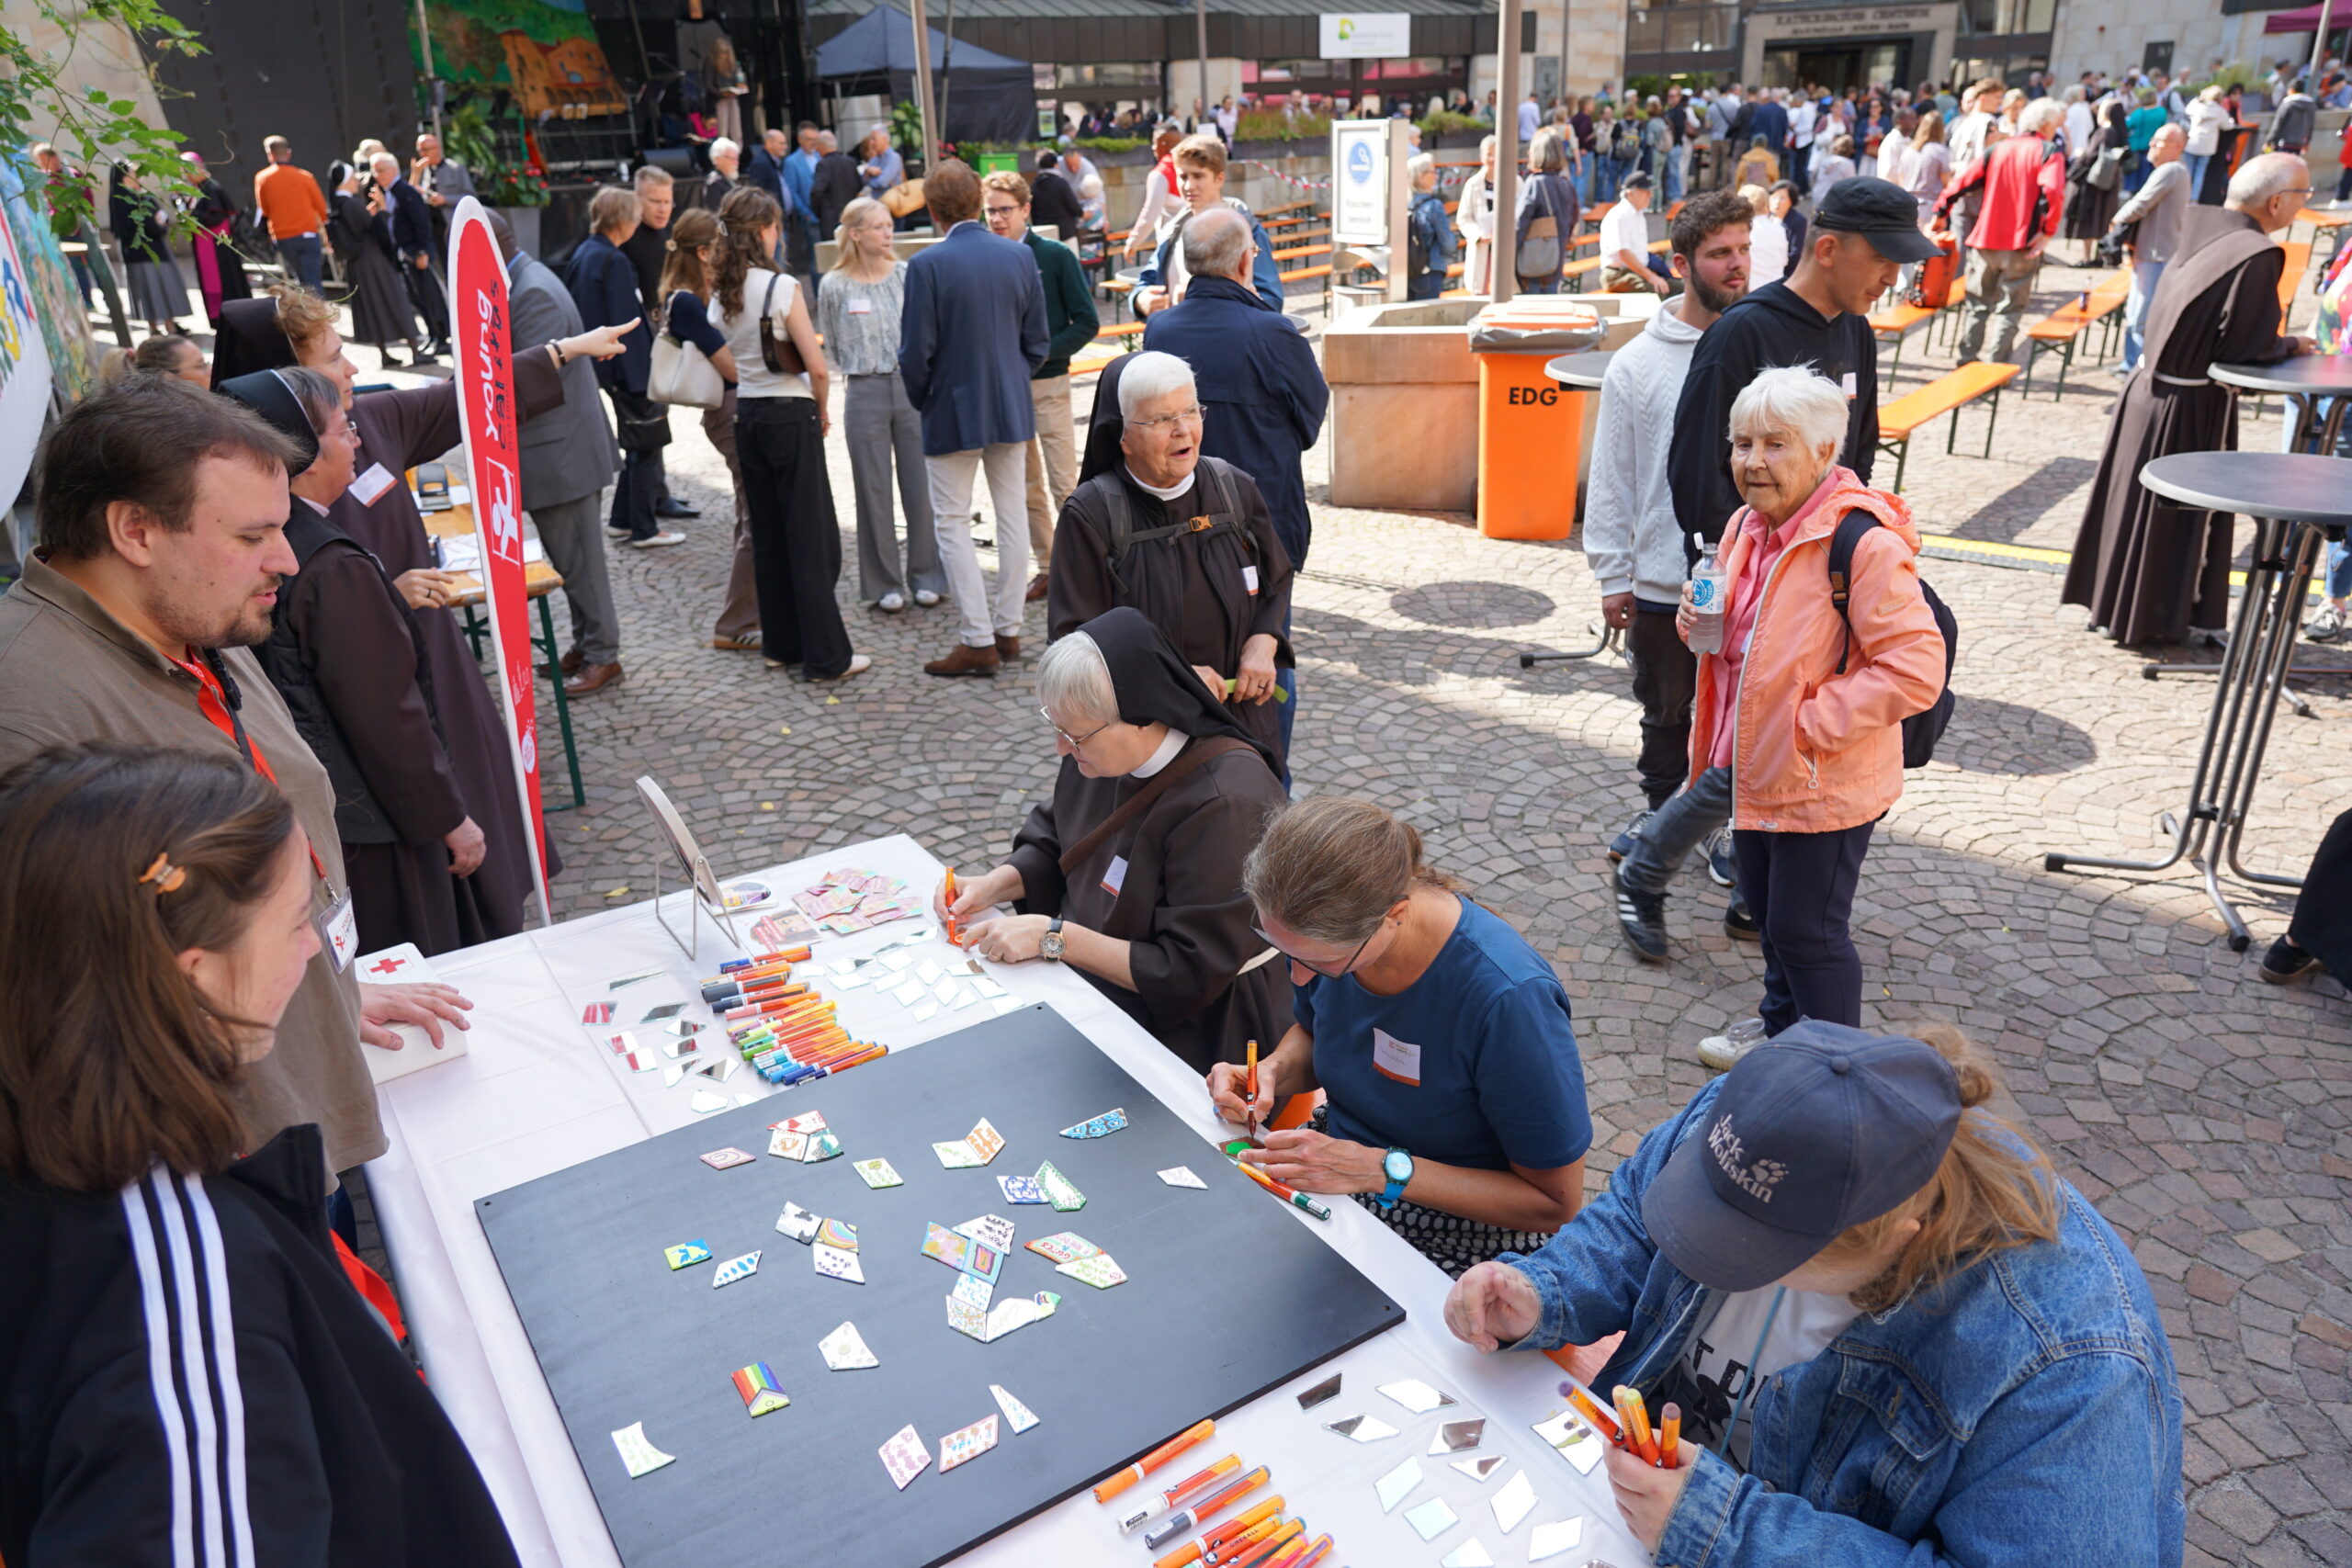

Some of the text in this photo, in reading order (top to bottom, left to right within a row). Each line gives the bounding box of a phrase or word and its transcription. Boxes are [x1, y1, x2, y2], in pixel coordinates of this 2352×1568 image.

[477, 288, 499, 442] young
[1509, 387, 1558, 406] EDG
[1708, 1122, 1772, 1203] Wolfskin
[1720, 1113, 1745, 1162] Jack
